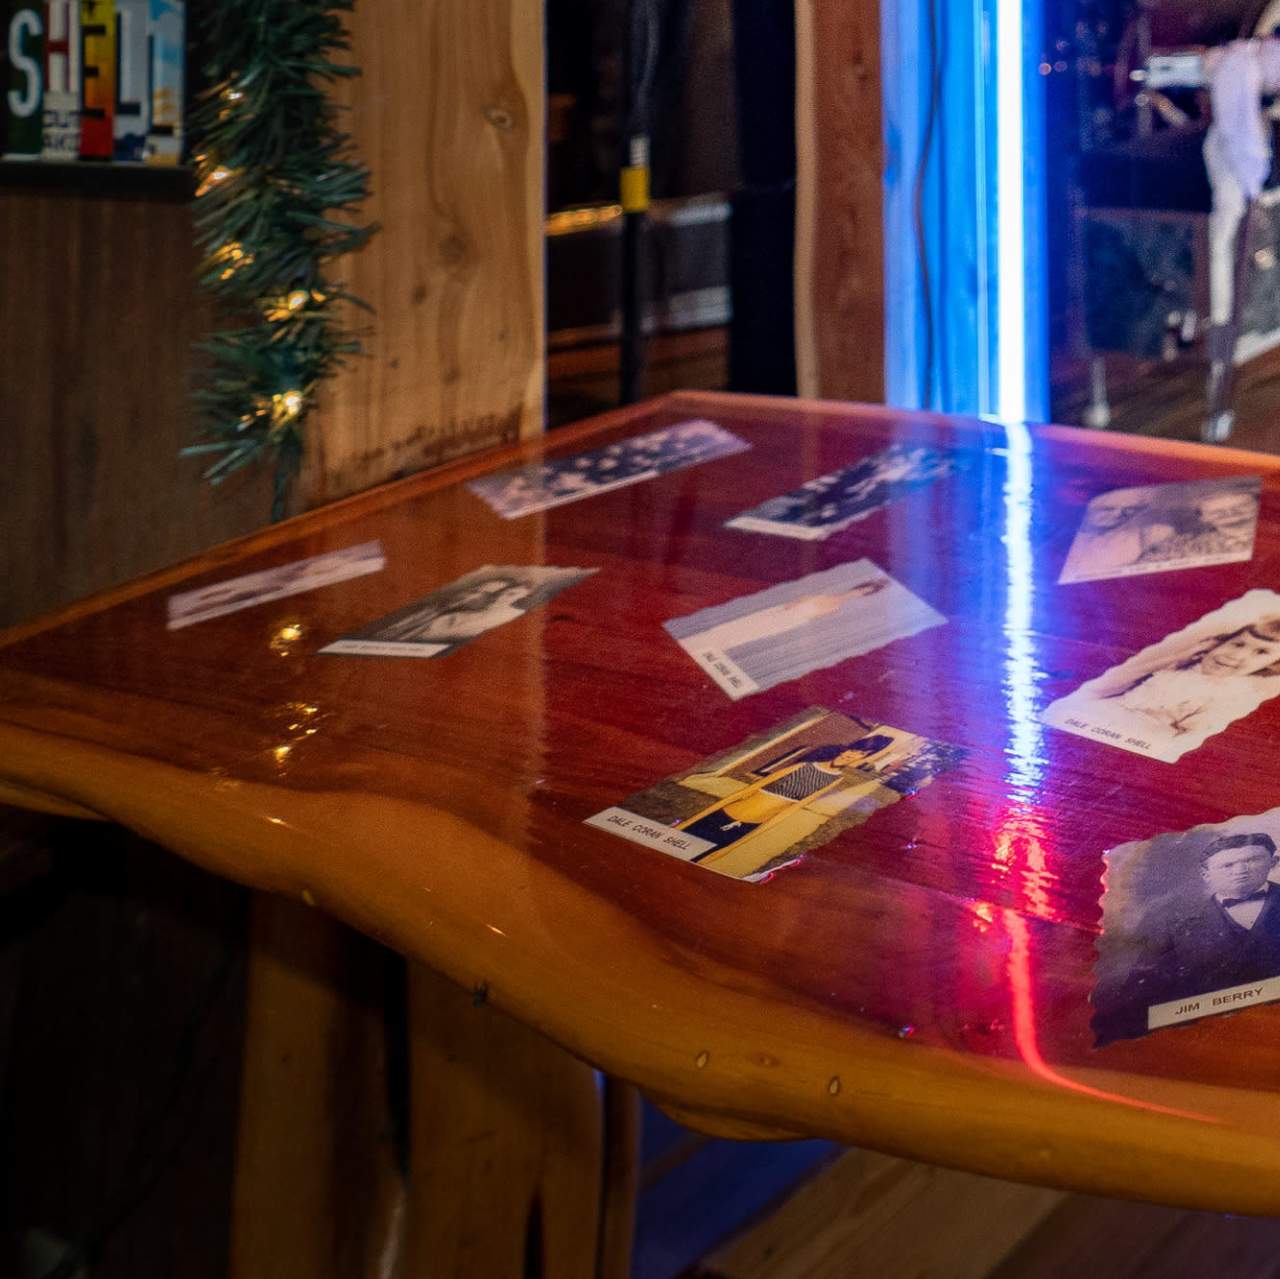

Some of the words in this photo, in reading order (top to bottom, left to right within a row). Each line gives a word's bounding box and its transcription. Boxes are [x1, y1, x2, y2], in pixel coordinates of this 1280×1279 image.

[1064, 718, 1089, 729] DALE
[1125, 737, 1152, 750] SHELL
[607, 815, 633, 828] DALE
[632, 824, 663, 840] CORAN
[663, 836, 691, 850] SHELL
[1174, 1002, 1201, 1016] JIM
[1212, 987, 1264, 1006] BERRY
